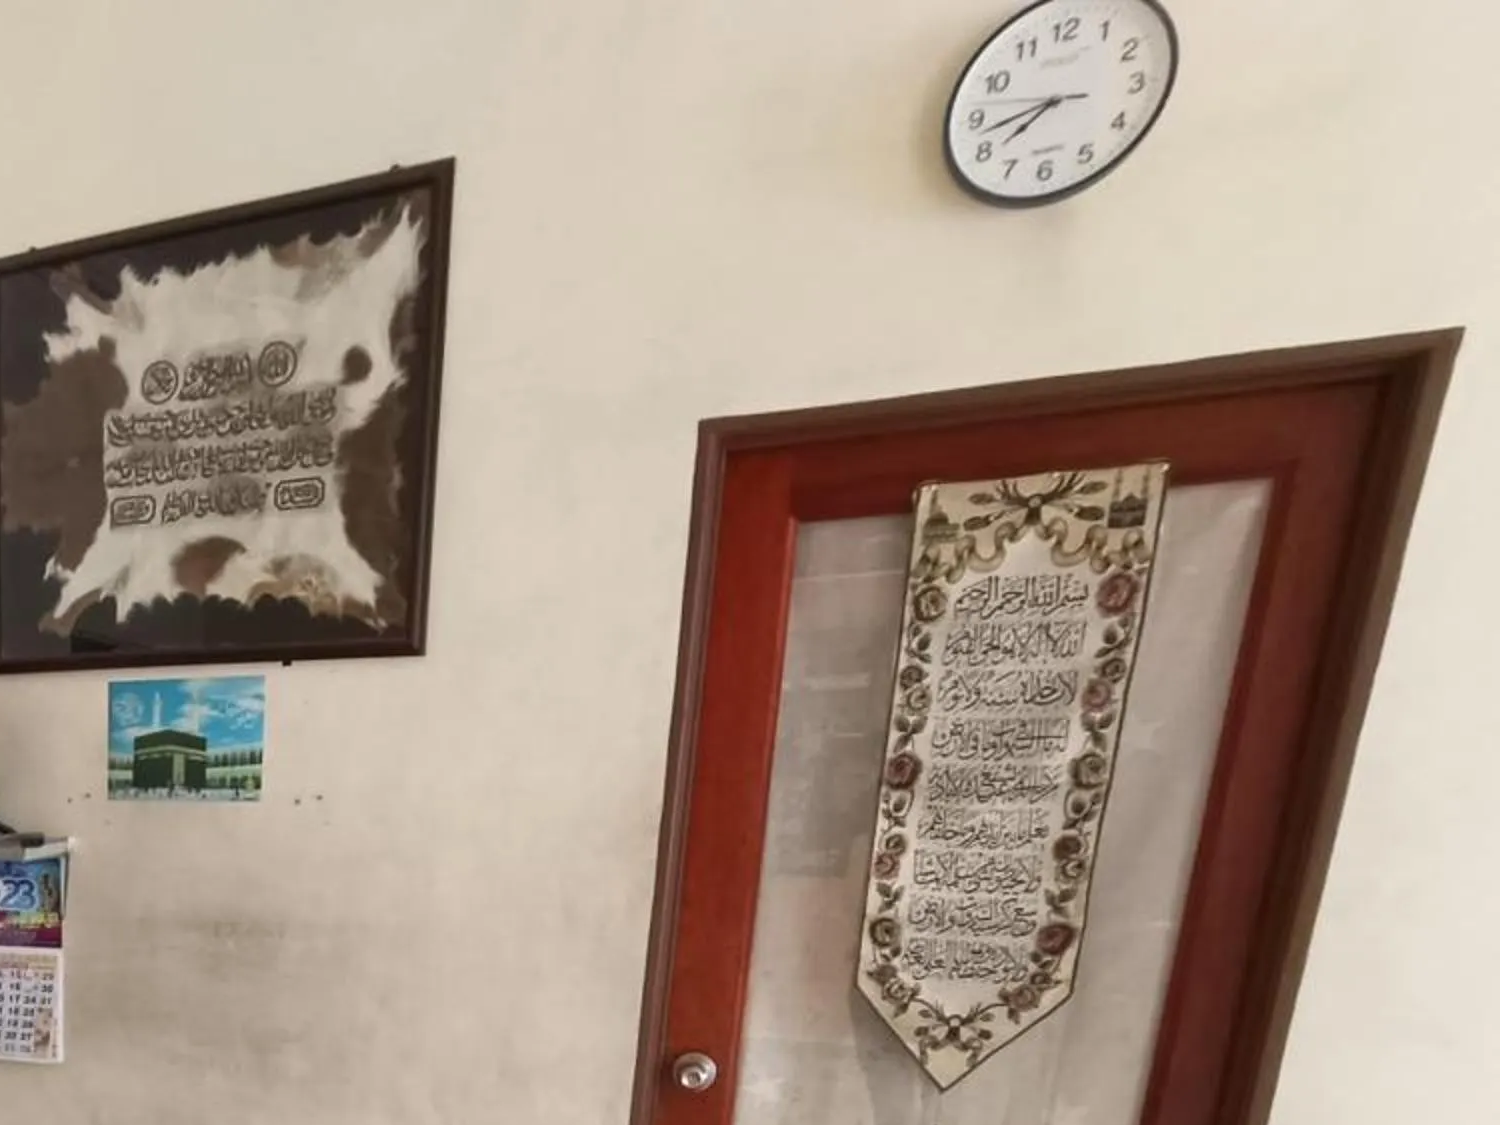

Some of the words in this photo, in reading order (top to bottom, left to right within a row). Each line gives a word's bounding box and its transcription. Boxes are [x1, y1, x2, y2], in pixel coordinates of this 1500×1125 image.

[1053, 17, 1081, 43] 12
[1099, 20, 1111, 42] 1
[1016, 37, 1038, 62] 11
[1121, 38, 1139, 63] 2
[985, 70, 1011, 95] 10
[1128, 72, 1146, 95] 3
[968, 108, 985, 131] 9
[1111, 111, 1127, 132] 4
[975, 140, 993, 163] 8
[1077, 143, 1094, 165] 5
[1002, 159, 1019, 181] 7
[1036, 160, 1054, 181] 6
